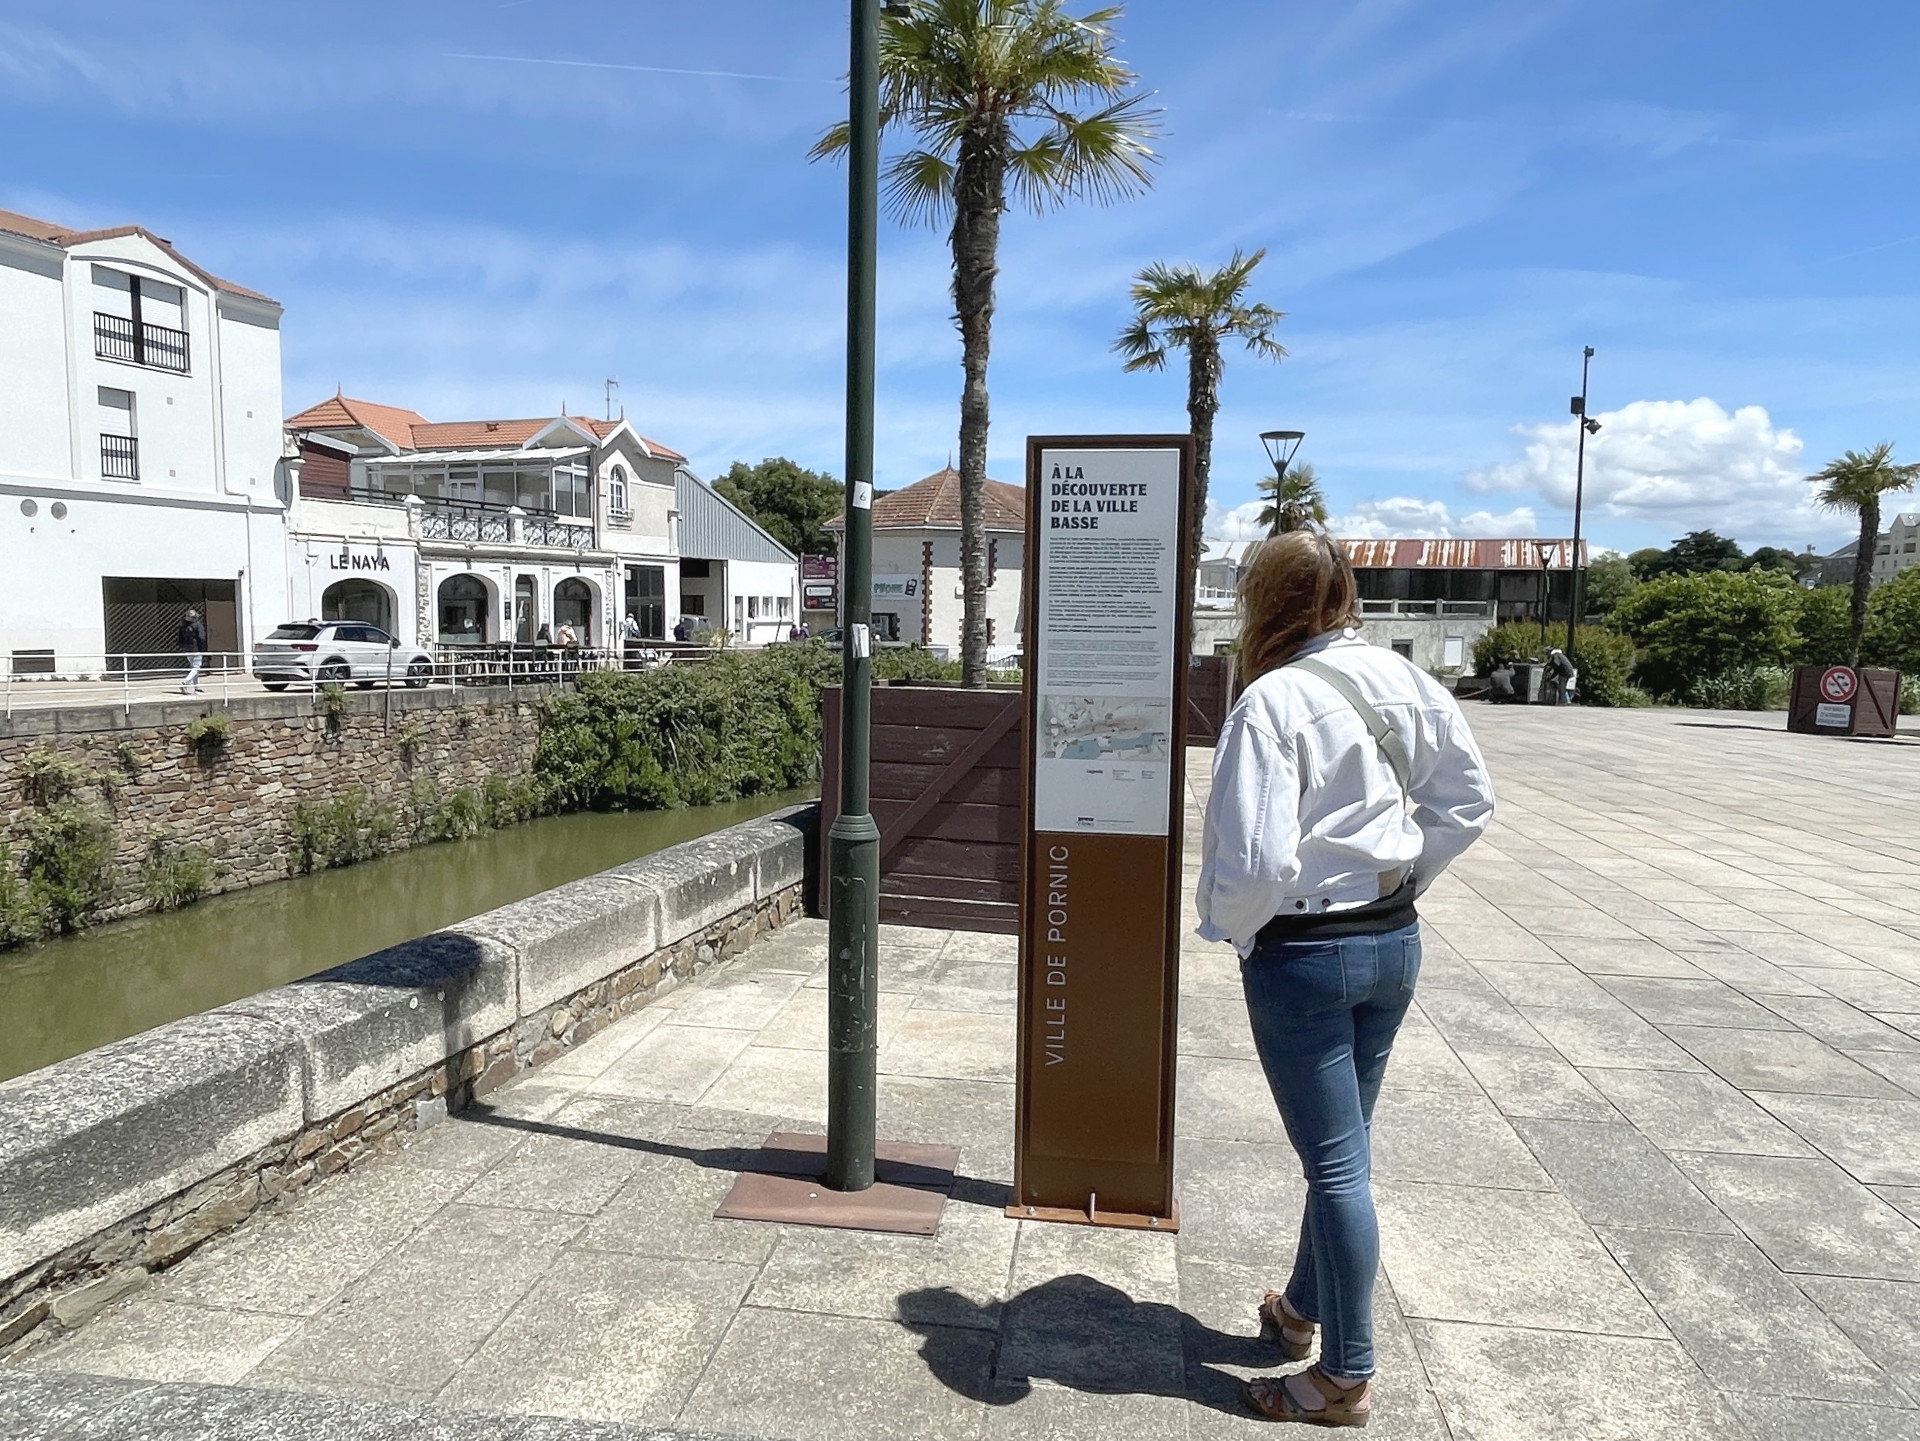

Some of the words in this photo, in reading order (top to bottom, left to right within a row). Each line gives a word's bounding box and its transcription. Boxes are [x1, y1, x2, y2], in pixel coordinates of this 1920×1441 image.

[1051, 463, 1061, 479] À
[1065, 466, 1084, 479] LA
[1051, 480, 1147, 496] DÉCOUVERTE
[1051, 500, 1070, 513] DE
[1073, 500, 1092, 513] LA
[1096, 500, 1138, 513] VILLE
[1051, 516, 1099, 529] BASSE
[330, 554, 348, 570] LE
[352, 554, 390, 571] NAYA
[1047, 845, 1069, 943] PORNIC
[1047, 955, 1067, 986] DE
[1045, 998, 1066, 1067] VILLE
